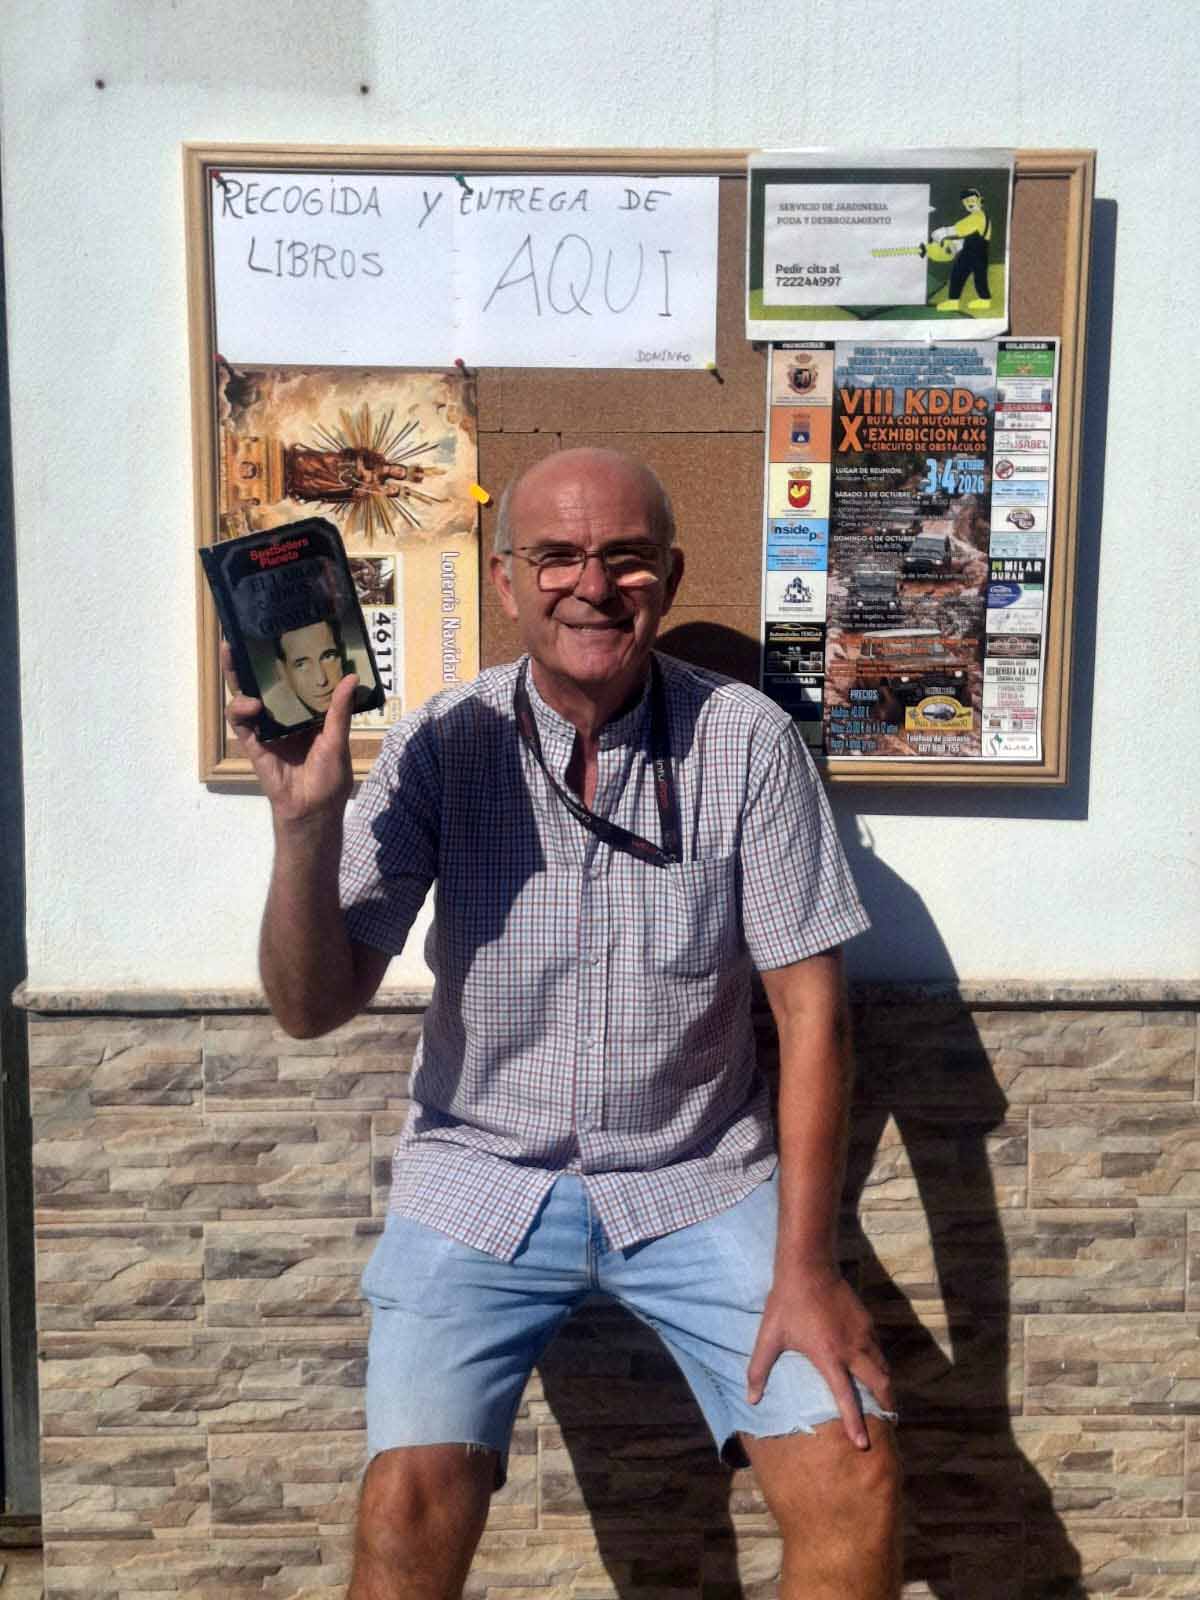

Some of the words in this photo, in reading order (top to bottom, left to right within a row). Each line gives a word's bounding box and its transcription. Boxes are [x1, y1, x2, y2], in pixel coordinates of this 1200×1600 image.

[222, 177, 382, 219] RECOGIDA
[459, 186, 589, 215] ENTREGA
[618, 188, 673, 212] DE
[780, 203, 820, 211] SERVICIO
[822, 203, 833, 211] DE
[777, 216, 802, 224] PODA
[804, 216, 810, 224] Y
[811, 216, 892, 224] DESBROZAMIENTO
[248, 236, 384, 280] LIBROS
[482, 233, 673, 317] AQUI
[776, 264, 802, 274] Pedir
[806, 264, 827, 274] cita
[829, 264, 840, 274] al
[776, 276, 841, 287] 722244997
[839, 387, 895, 415] VIII
[866, 415, 894, 425] RUTA
[897, 415, 919, 425] CON
[838, 415, 864, 453] X
[871, 443, 913, 452] CIRCUITO
[914, 443, 927, 452] DE
[1004, 560, 1042, 572] MILAR
[375, 612, 393, 691] 46117
[441, 616, 461, 683] Navidad
